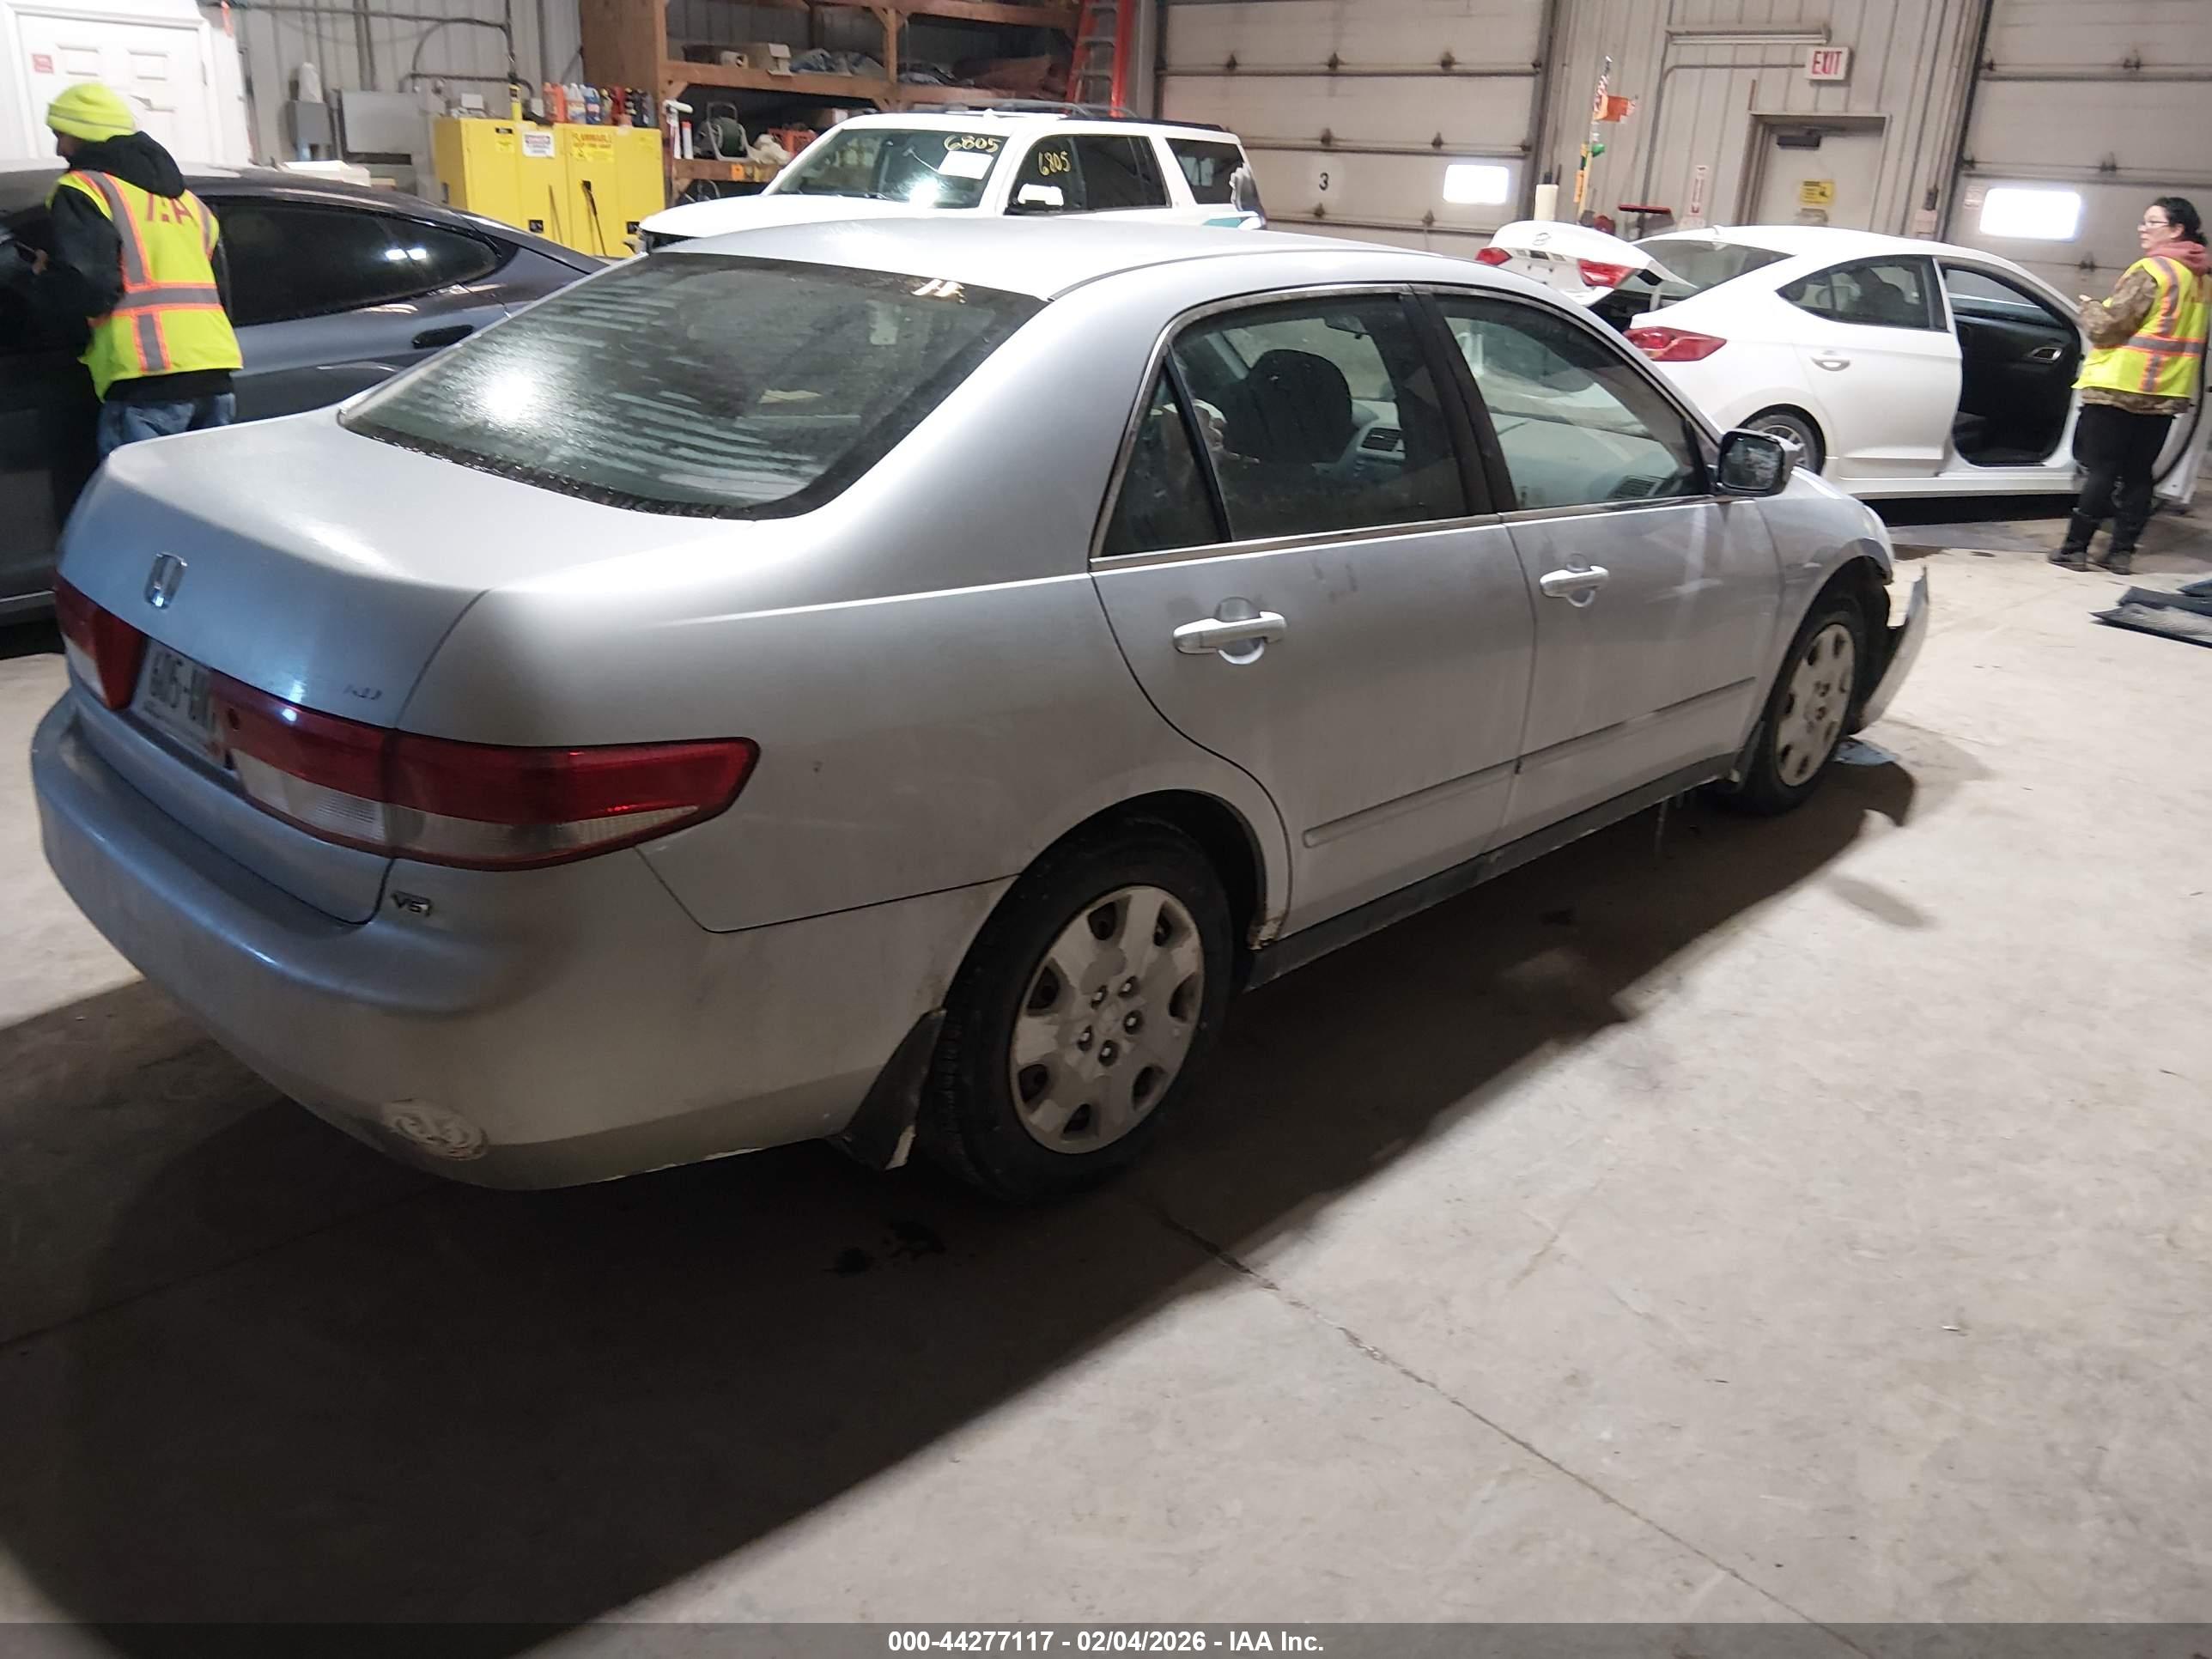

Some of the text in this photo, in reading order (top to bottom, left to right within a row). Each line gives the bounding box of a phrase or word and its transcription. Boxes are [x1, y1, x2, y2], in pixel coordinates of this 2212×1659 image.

[1812, 50, 1843, 76] EXIT
[944, 135, 1002, 153] 6805
[1038, 150, 1071, 176] 6805
[1318, 172, 1329, 191] 3
